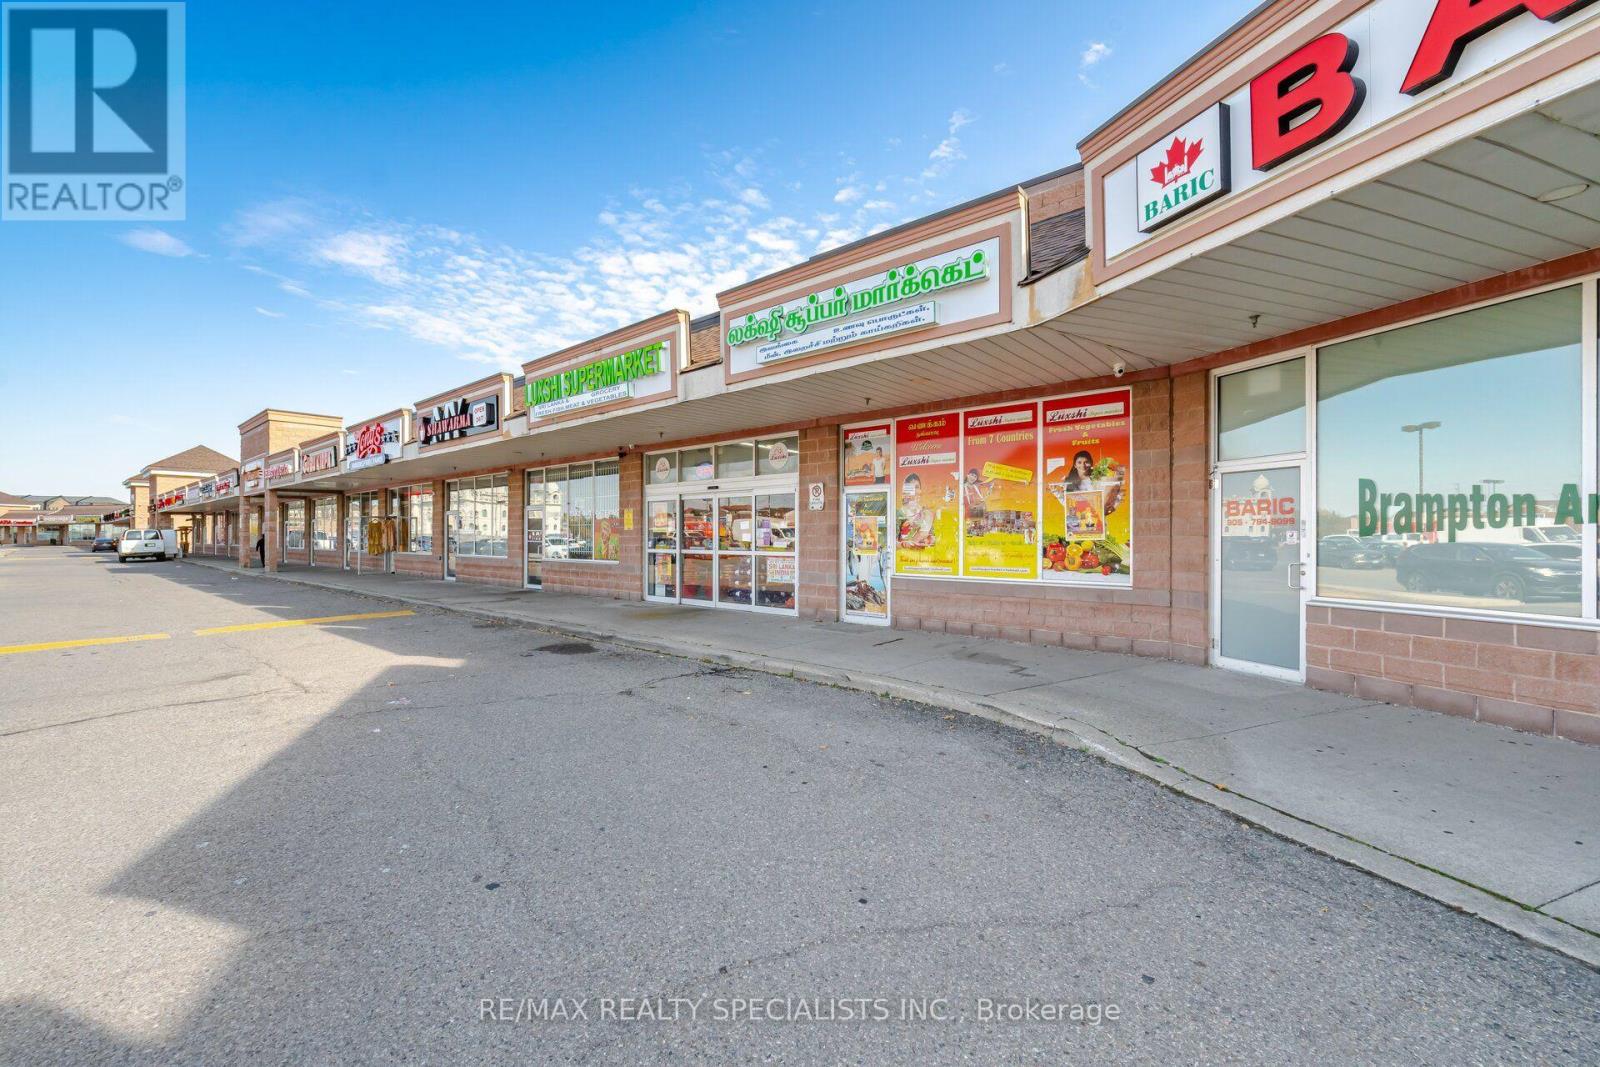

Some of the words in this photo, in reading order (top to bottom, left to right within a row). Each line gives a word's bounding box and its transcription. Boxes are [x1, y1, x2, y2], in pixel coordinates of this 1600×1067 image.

[1144, 167, 1215, 222] BARIC
[525, 373, 563, 408] LUXSHI
[562, 341, 665, 397] SUPERMARKET
[587, 390, 627, 405] VEGETABLES
[590, 385, 621, 398] GROCERY
[969, 415, 1003, 428] Luxshi
[1049, 408, 1088, 421] Luxshi
[427, 414, 471, 437] SHAWARMA
[1075, 420, 1126, 431] Vegetables
[968, 436, 986, 446] From
[989, 433, 994, 444] 7
[996, 431, 1034, 443] Countries
[1072, 438, 1100, 446] Fruits
[900, 455, 930, 467] Luxshi
[1226, 497, 1296, 517] BARIC
[1358, 478, 1536, 543] Brampton
